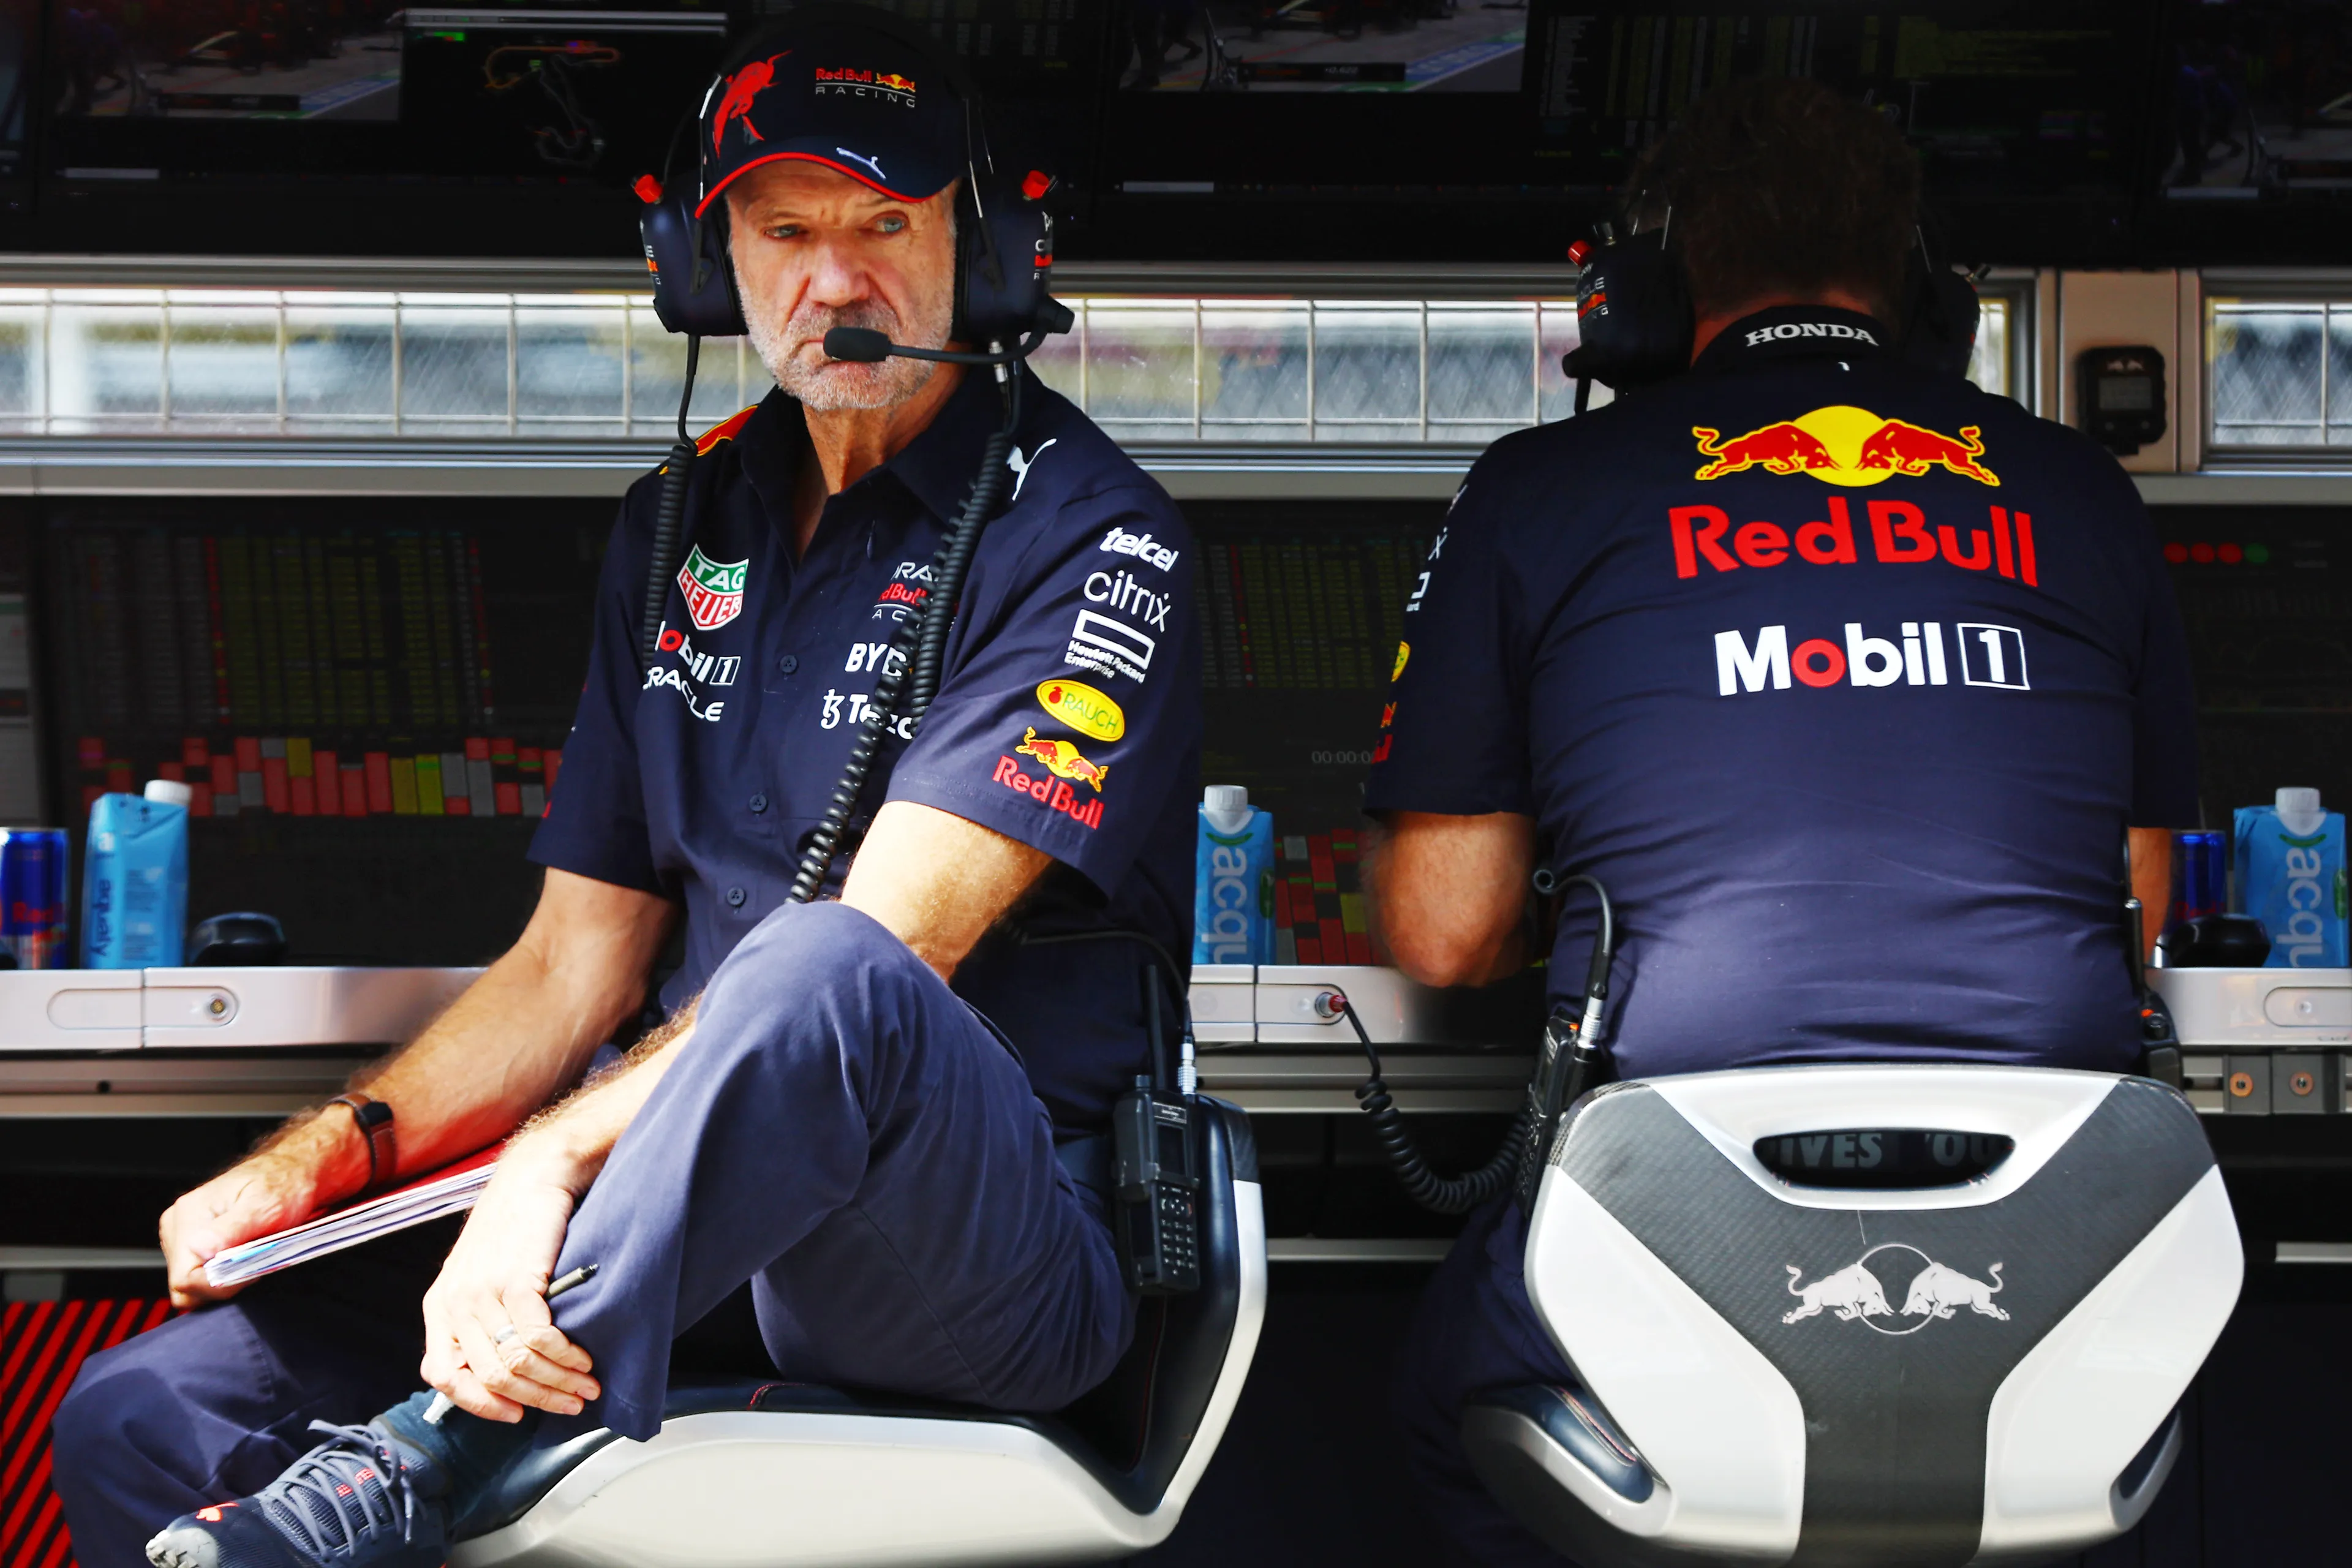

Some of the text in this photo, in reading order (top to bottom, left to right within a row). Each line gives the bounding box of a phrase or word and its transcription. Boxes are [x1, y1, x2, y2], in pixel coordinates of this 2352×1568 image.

[815, 68, 872, 82] Red Bull
[815, 86, 915, 108] RACING
[1745, 323, 1879, 347] HONDA
[1099, 527, 1180, 572] telcel
[1668, 496, 2038, 587] Red Bull
[696, 554, 745, 590] TAG
[681, 570, 741, 625] HEUER
[1064, 652, 1115, 679] Enterprise
[1714, 622, 1948, 696] Mobil
[643, 666, 725, 722] RACLE
[1063, 692, 1120, 733] RAUCH
[992, 755, 1104, 830] Red Bull
[1779, 1132, 1883, 1168] IVES
